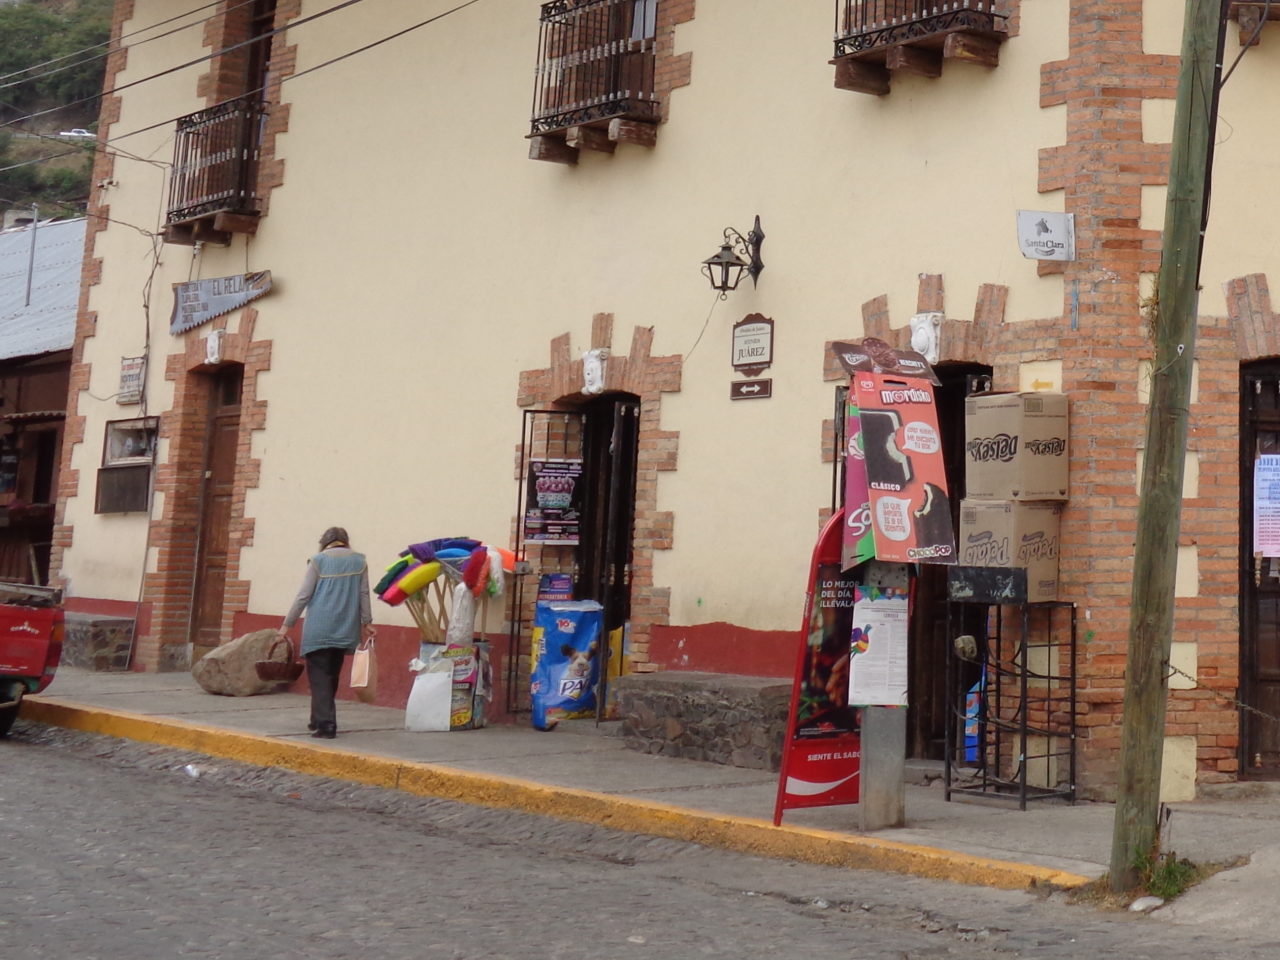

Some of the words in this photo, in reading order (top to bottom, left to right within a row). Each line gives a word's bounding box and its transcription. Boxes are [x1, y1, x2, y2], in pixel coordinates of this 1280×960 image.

[1025, 239, 1045, 248] Santa
[1045, 240, 1065, 249] Clara
[737, 346, 765, 361] JUÁREZ
[973, 433, 1018, 462] Delsey
[1033, 437, 1065, 456] Delsey
[871, 482, 900, 491] CLÁSICO
[908, 545, 951, 558] CHOCOPOP
[807, 753, 832, 761] SIENTE
